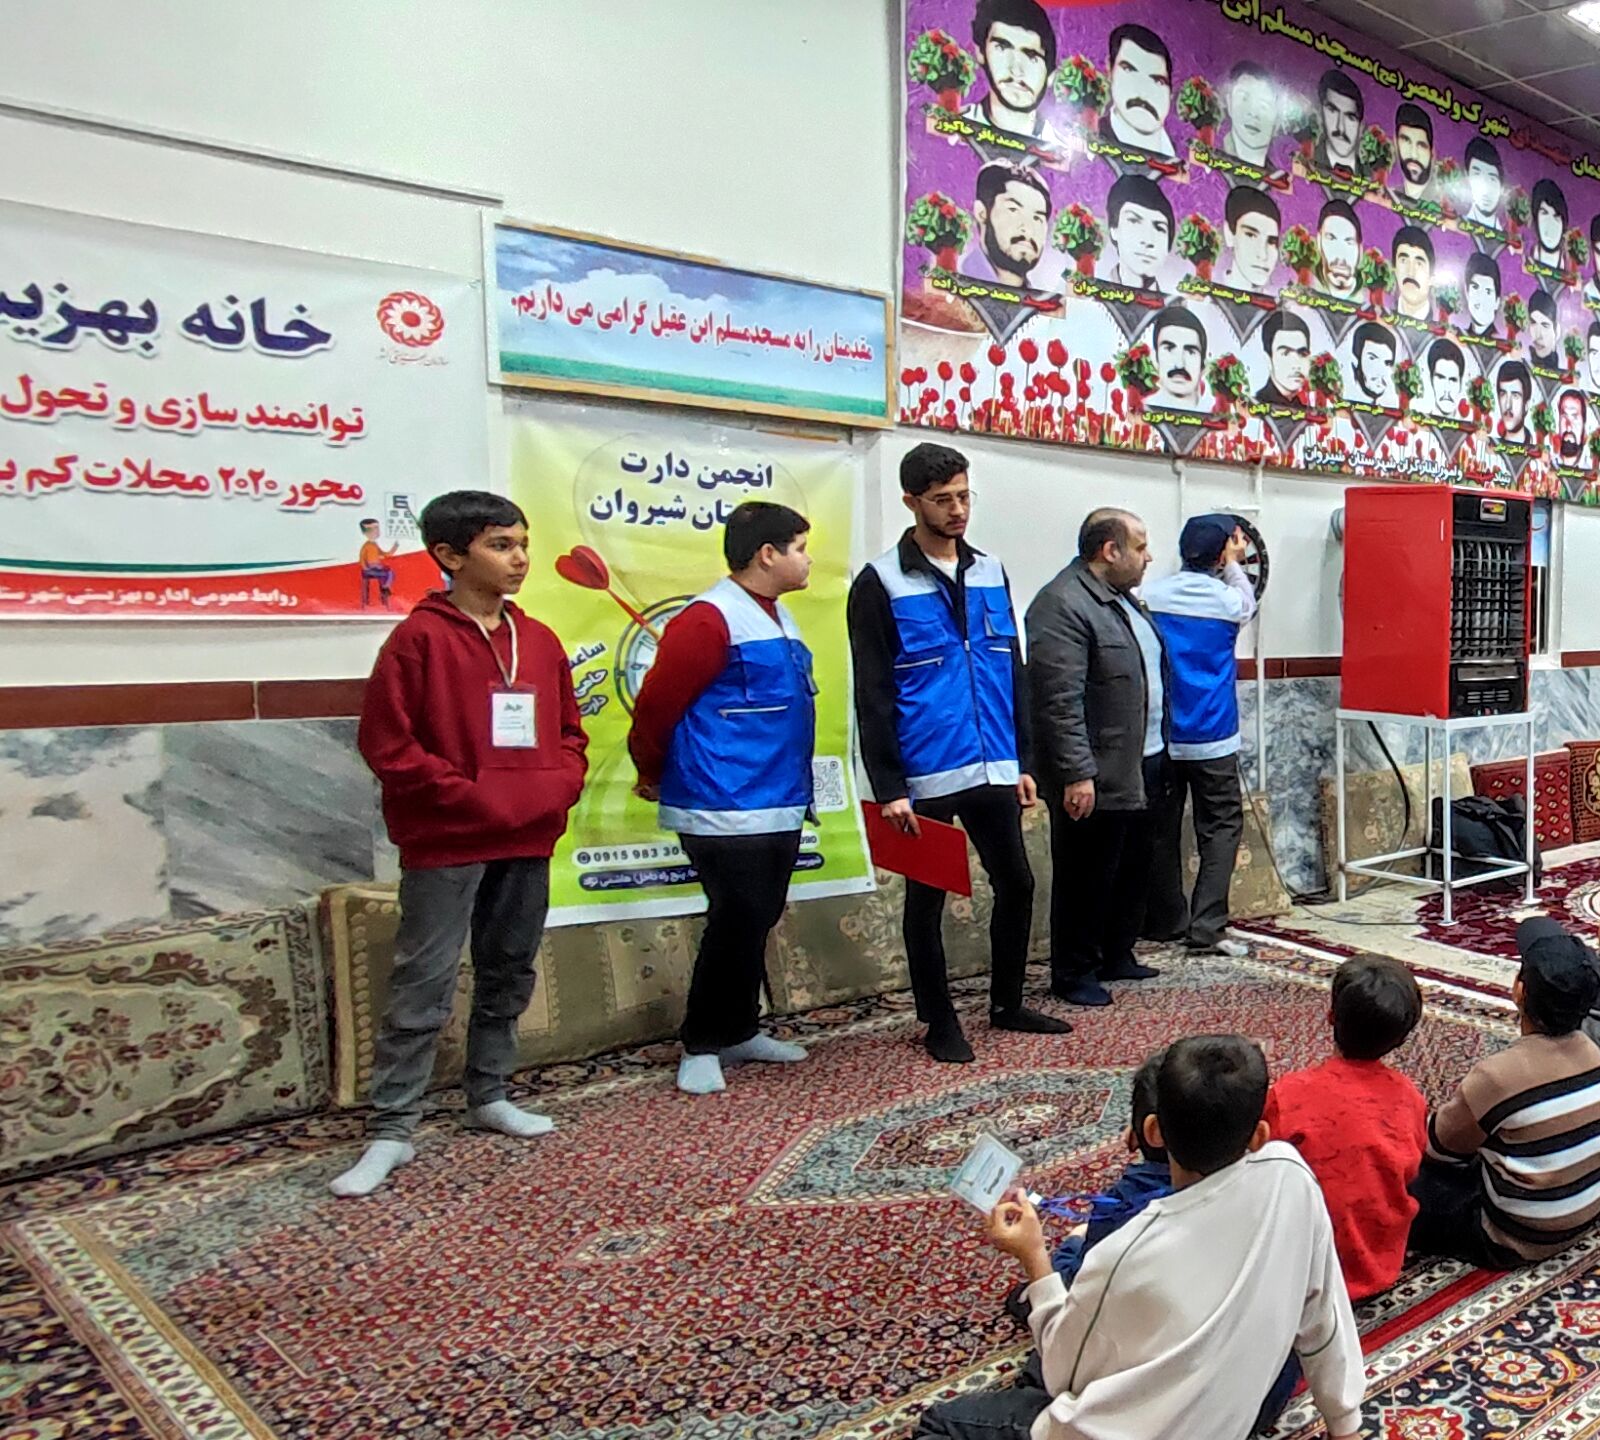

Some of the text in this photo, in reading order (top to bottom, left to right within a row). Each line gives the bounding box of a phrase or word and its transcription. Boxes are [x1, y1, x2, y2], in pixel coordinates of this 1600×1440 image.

[1260, 8, 1314, 45] مسلم
[1315, 34, 1374, 75] مسجد
[0, 282, 332, 353] خانه بهزی
[567, 301, 594, 326] می
[597, 296, 648, 335] گرامی
[650, 303, 687, 337] عقیل
[690, 311, 713, 344] ابن
[716, 312, 750, 346] مسلم
[750, 325, 791, 353] مسجد
[793, 330, 807, 358] به
[823, 332, 873, 363] مقدمتان
[0, 373, 365, 442] توانمند سازی و تحول
[620, 450, 773, 494] انجمن دارت
[1305, 446, 1346, 465] شیروان
[26, 454, 79, 493] کم
[83, 457, 210, 492] محلات
[217, 466, 278, 494] ۲۰۲۰
[280, 478, 363, 507] محور
[589, 487, 687, 526] شیروان
[190, 589, 249, 607] عمومی
[252, 586, 299, 607] روابط
[593, 849, 629, 863] 0915
